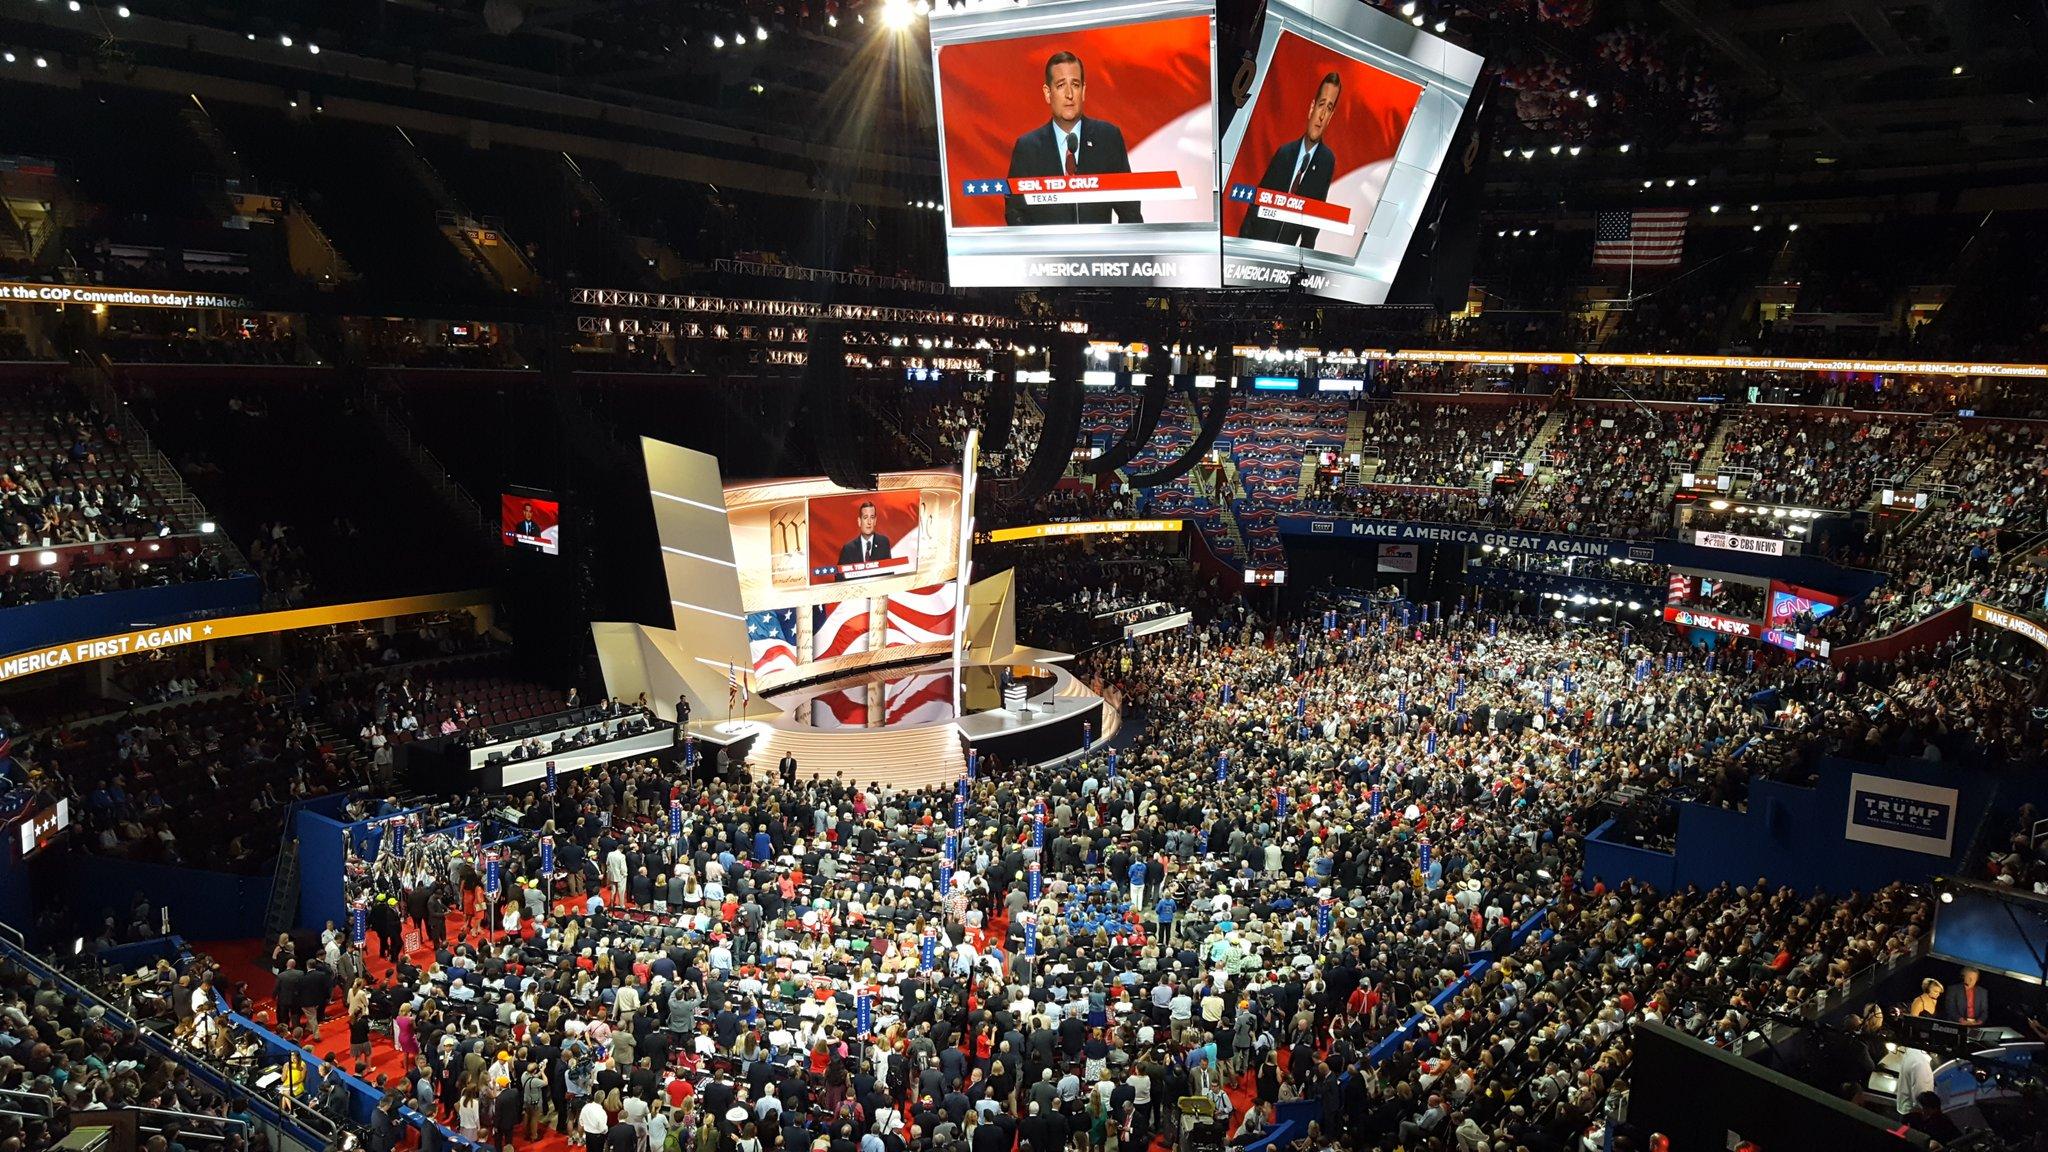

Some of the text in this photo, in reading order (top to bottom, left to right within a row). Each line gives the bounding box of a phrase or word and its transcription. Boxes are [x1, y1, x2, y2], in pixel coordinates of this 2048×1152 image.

[1018, 177, 1099, 191] SEN. TED CRUZ
[1032, 195, 1058, 203] TEXAS
[1273, 194, 1287, 206] TED
[1287, 197, 1305, 211] CRUZ
[1261, 208, 1277, 218] TEXAS
[1029, 263, 1090, 277] AMERICA
[1092, 262, 1130, 277] FIRST
[1132, 262, 1177, 277] AGAIN
[1234, 265, 1271, 282] AMERICA
[1297, 274, 1326, 290] GAIN
[13, 286, 38, 299] the
[40, 288, 71, 300] GOP
[74, 290, 150, 304] Convention
[152, 293, 193, 308] today!
[1409, 353, 1434, 361] speech
[1655, 357, 1683, 365] Florida
[1685, 358, 1724, 367] Governor
[1726, 358, 1743, 367] Rick
[1745, 359, 1771, 367] Scott!
[1773, 360, 1852, 370] #TrumpPence2016
[1854, 362, 1917, 372] #AmericaFirst
[1970, 366, 2047, 376] #RNCConvention
[1069, 523, 1104, 533] AMERICA
[1352, 523, 1608, 556] MAKE AMERICA GREAT AGAIN!
[1740, 538, 1776, 553] CBS NEWS
[1776, 598, 1811, 617] CNN
[1693, 614, 1750, 636] NBC NEWS
[1986, 610, 2008, 626] MAKE
[77, 637, 130, 661] FIRST
[135, 626, 192, 650] AGAIN
[1865, 798, 1940, 818] TRUMP
[1870, 809, 1931, 826] PENCE
